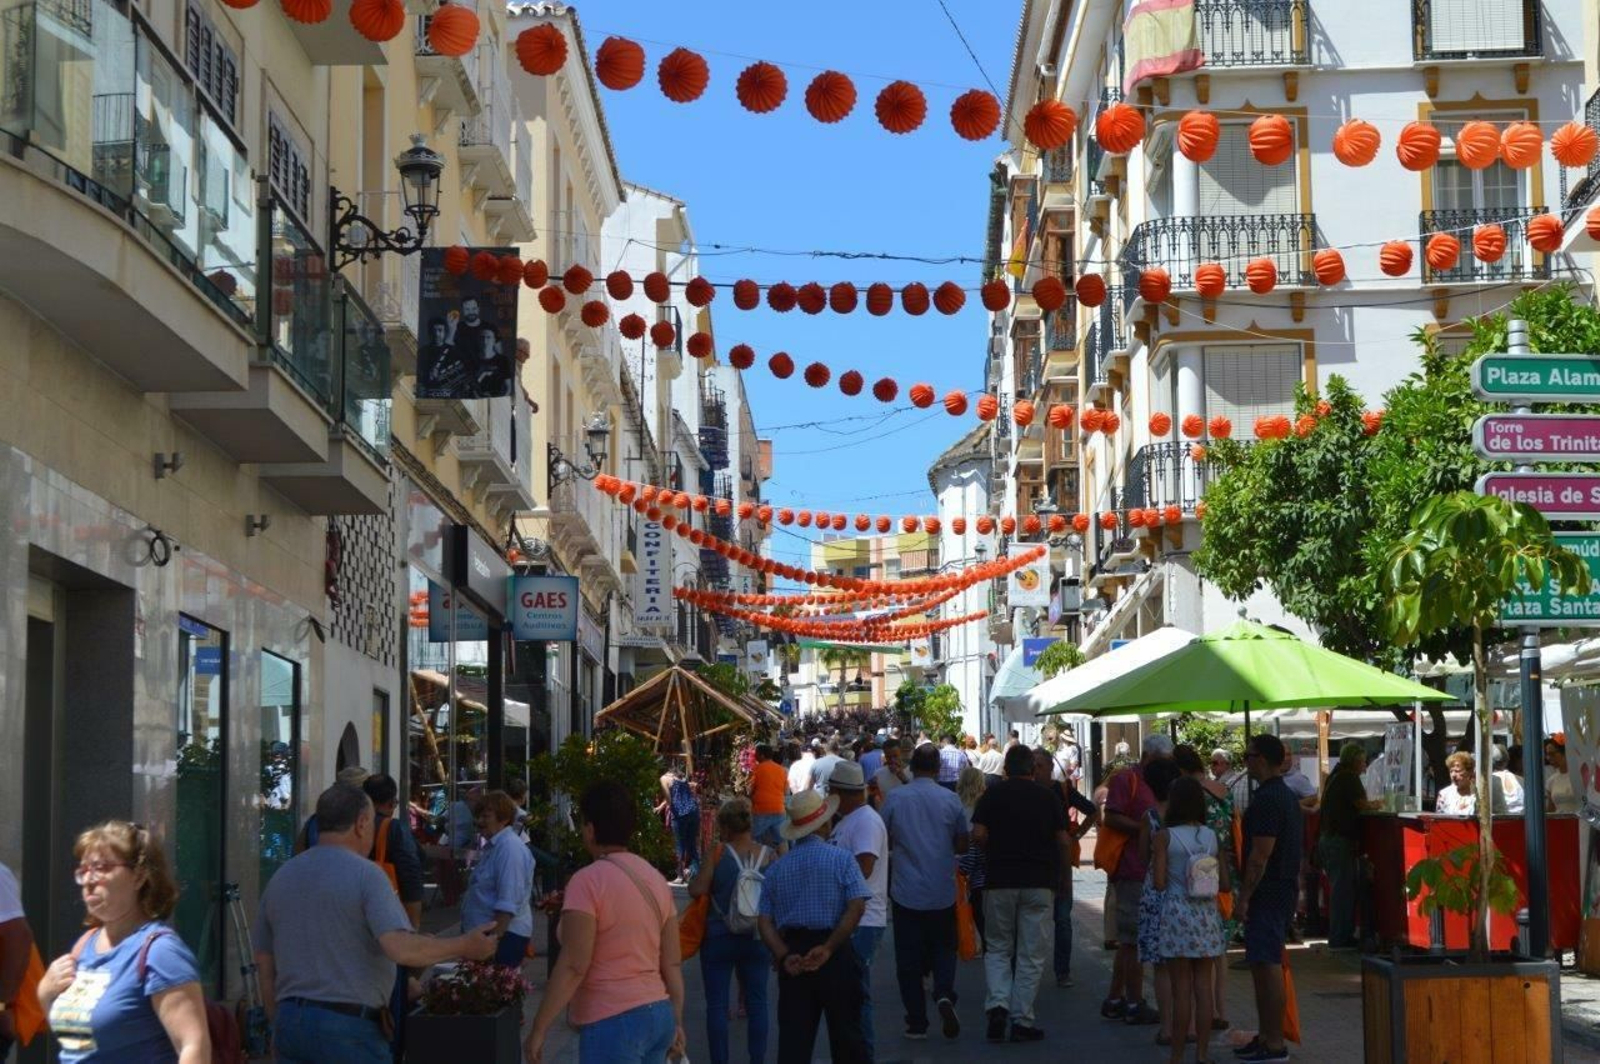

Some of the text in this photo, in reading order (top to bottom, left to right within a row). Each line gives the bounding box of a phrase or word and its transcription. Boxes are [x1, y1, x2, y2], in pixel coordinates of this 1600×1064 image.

[1487, 367, 1541, 385] Plaza
[1488, 421, 1524, 433] Torre
[1489, 435, 1511, 450] de
[1517, 435, 1543, 450] los
[1560, 486, 1583, 503] de
[644, 522, 660, 613] CONFITERIA
[521, 592, 567, 608] GAES
[1549, 597, 1600, 615] Santa
